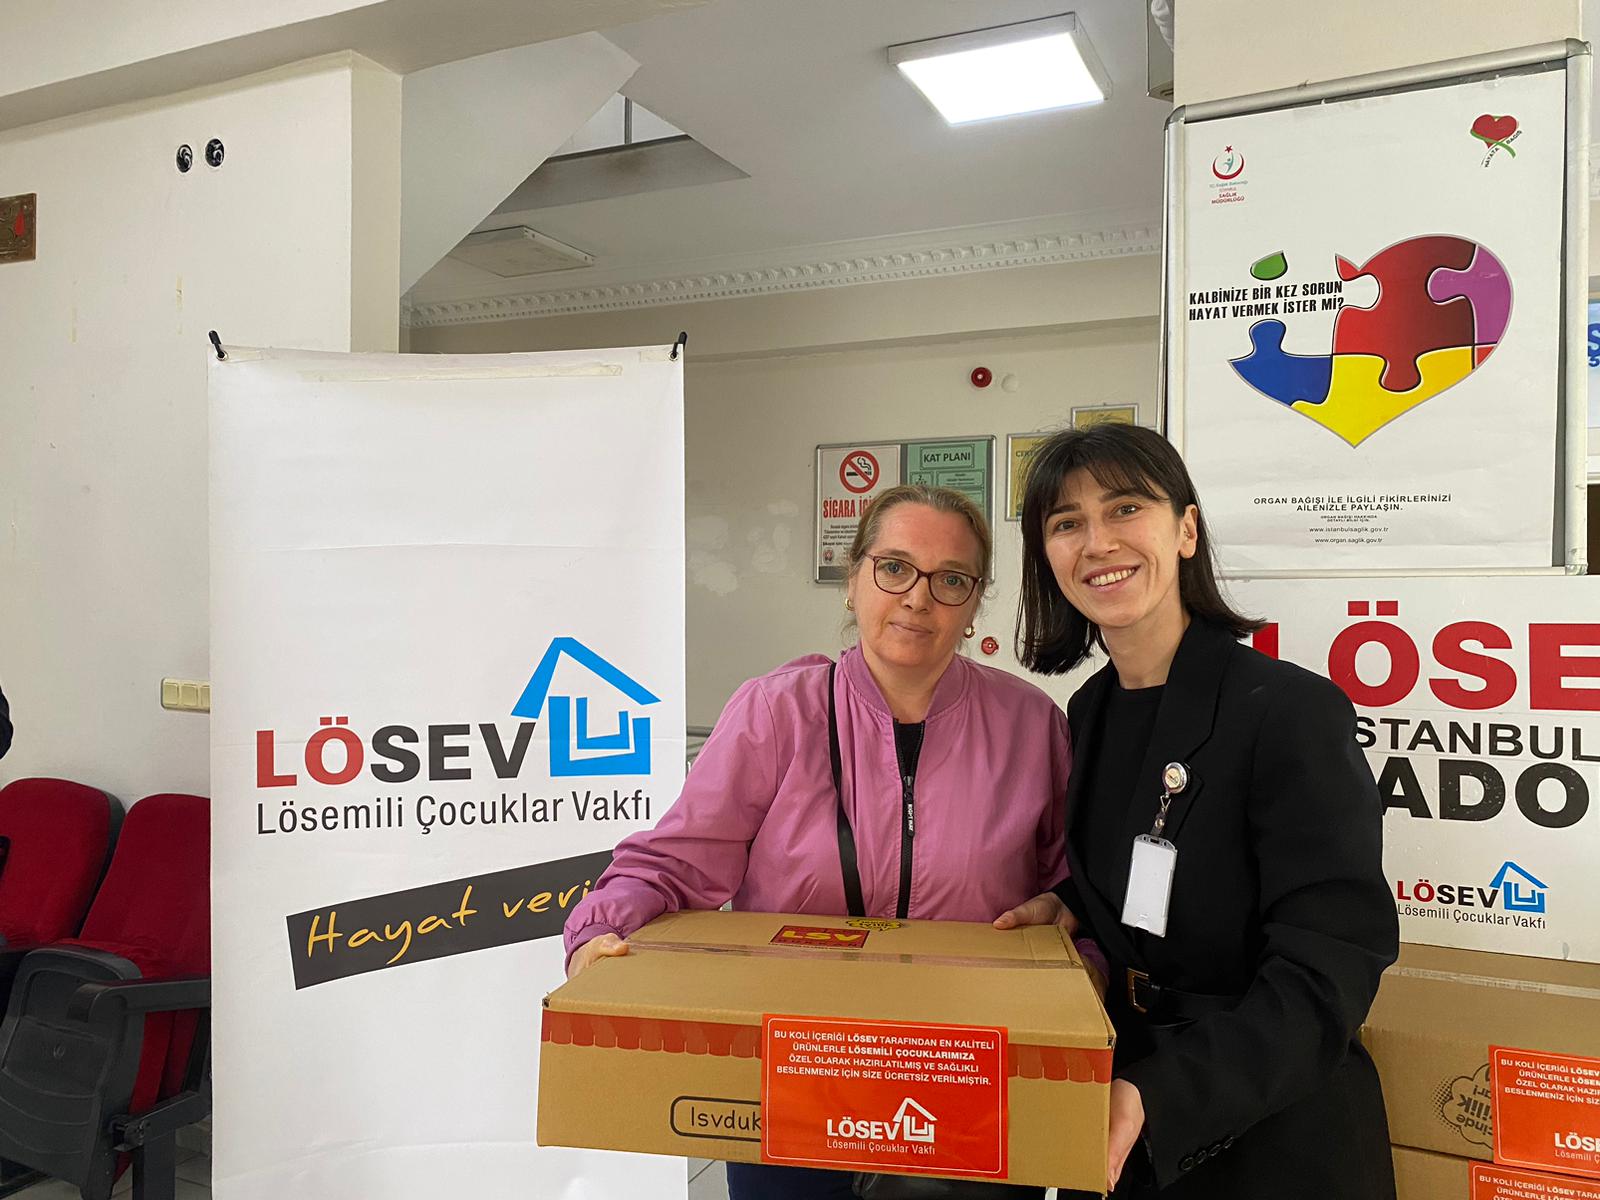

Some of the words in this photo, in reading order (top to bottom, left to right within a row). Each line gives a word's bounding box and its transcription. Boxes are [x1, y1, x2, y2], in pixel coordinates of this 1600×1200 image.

[1189, 287, 1248, 305] KALBİNİZE
[1252, 285, 1271, 300] BİR
[1276, 284, 1297, 298] KEZ
[1302, 281, 1343, 296] SORUN
[1189, 306, 1227, 321] HAYAT
[1232, 302, 1279, 318] VERMEK
[1283, 299, 1317, 314] İSTER
[1321, 295, 1344, 310] Mİ?
[923, 453, 941, 463] KAT
[943, 452, 971, 462] PLANI
[823, 497, 856, 518] SİGARA
[1291, 496, 1324, 505] BAĞIŞI
[1328, 495, 1343, 503] İLE
[1346, 494, 1376, 503] İLGİLİ
[1379, 493, 1452, 503] FİKİRLERİNİZİ
[1296, 503, 1347, 511] AİLENİZLE
[1350, 503, 1403, 512] PAYLAŞIN.
[1252, 600, 1600, 711] ÖSE
[1356, 716, 1600, 763] STANBUL
[256, 716, 536, 788] LÖSEV
[1377, 756, 1590, 829] ADO
[257, 797, 404, 834] Lösemili
[416, 793, 564, 835] Çocuklar
[572, 788, 652, 821] Vakfı
[1397, 879, 1499, 909] LÖSEV
[307, 885, 477, 965] Hayat
[1398, 903, 1449, 920] Lösemili
[1453, 909, 1510, 926] Çocuklar
[1512, 914, 1546, 929] Vakfı
[782, 930, 863, 941] LSV
[774, 1030, 787, 1039] BU
[789, 1031, 810, 1040] KOLİ
[812, 1031, 845, 1042] İÇERİĞİ
[847, 1033, 878, 1043] LÖSEV
[880, 1036, 937, 1047] TARAFINDAN
[939, 1039, 952, 1047] EN
[954, 1040, 994, 1050] KALİTELİ
[792, 1042, 847, 1053] ÜRÜNLERLE
[848, 1044, 893, 1056] LÖSEMİLİ
[895, 1049, 975, 1060] ÇOCUKLARIMIZA
[789, 1053, 812, 1063] ÖZEL
[814, 1056, 851, 1065] OLARAK
[853, 1058, 922, 1071] HAZIRLATILMIŞ
[924, 1061, 935, 1070] VE
[937, 1062, 979, 1072] SAĞLIKLI
[1515, 1060, 1535, 1069] KOLİ
[1537, 1062, 1569, 1073] İÇERİĞİ
[776, 1065, 840, 1077] BESLENMENİZ
[841, 1068, 860, 1078] İÇİN
[862, 1069, 882, 1079] SİZE
[884, 1070, 930, 1082] ÜCRETSİZ
[931, 1074, 992, 1086] VERİLMİŞTİR.
[1515, 1078, 1538, 1088] ÖZEL
[1539, 1082, 1575, 1093] OLARAK
[1519, 1069, 1570, 1083] ÜRÜNLERLE
[1504, 1087, 1565, 1101] BESLENMENİZ
[1566, 1094, 1584, 1103] İÇİN
[826, 1116, 900, 1140] LÖSEV
[826, 1139, 866, 1150] Lösemili
[868, 1141, 909, 1153] Çocuklar
[912, 1144, 935, 1155] Vakfı
[1554, 1131, 1600, 1152] LÖS
[1554, 1149, 1592, 1161] Lösemili
[1479, 1175, 1491, 1183] BU
[1493, 1177, 1513, 1186] KOLİ
[1546, 1186, 1575, 1196] LÖSEV
